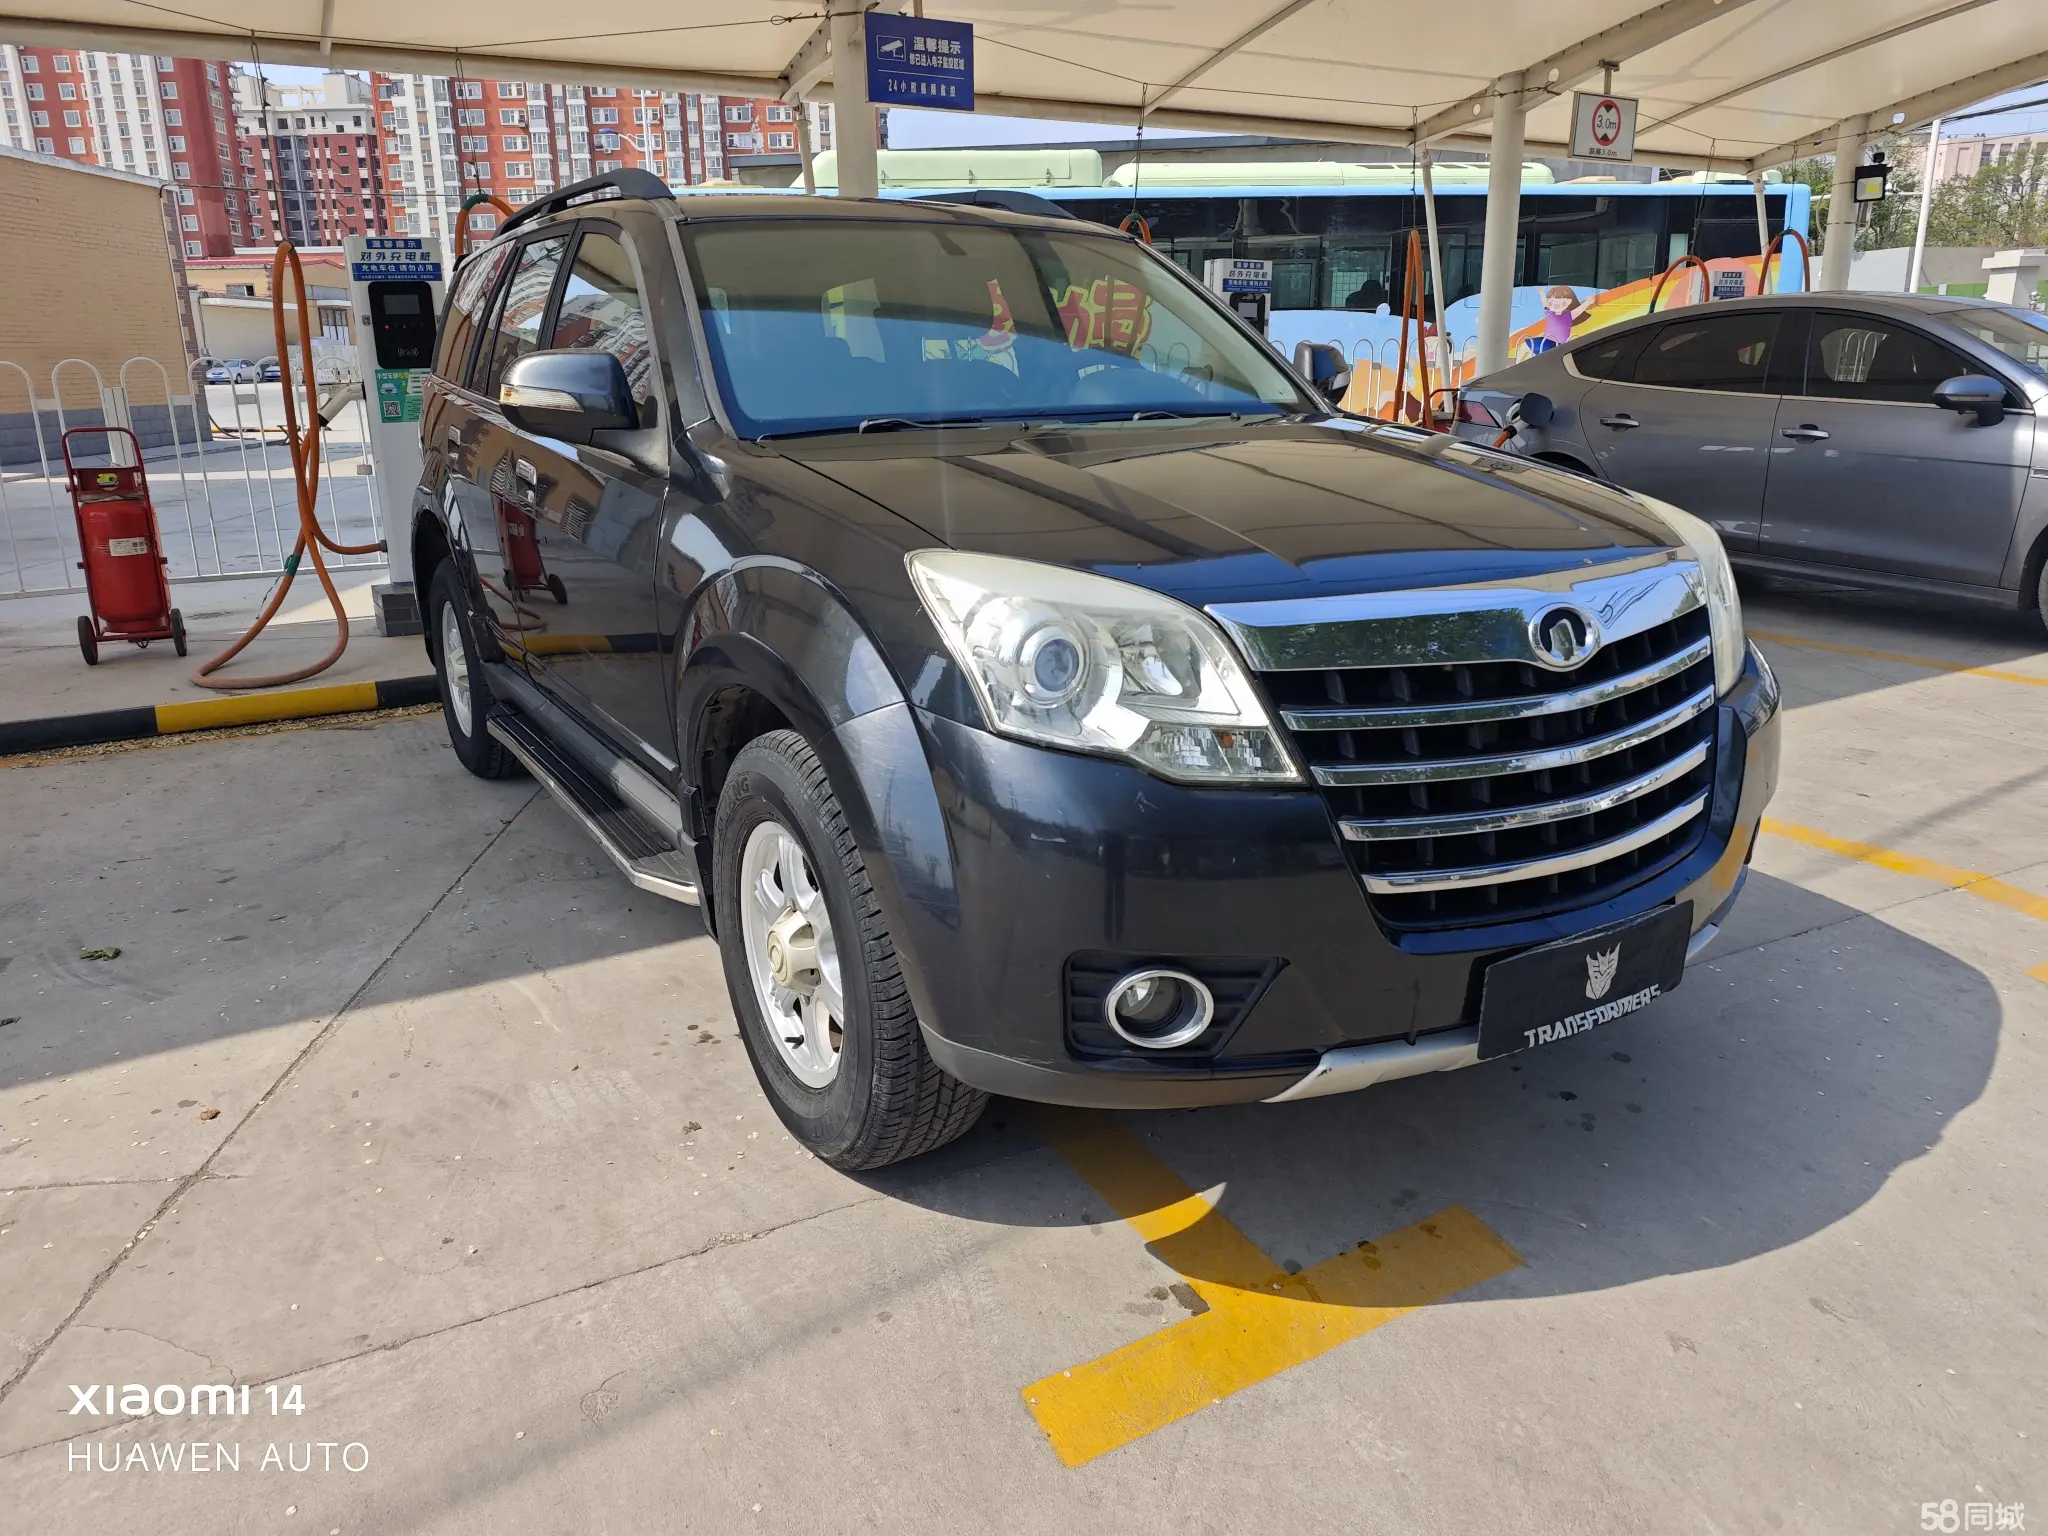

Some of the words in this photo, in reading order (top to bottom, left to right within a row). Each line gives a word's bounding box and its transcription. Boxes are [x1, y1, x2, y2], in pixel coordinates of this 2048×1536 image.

[913, 36, 961, 55] 温馨提示
[1597, 114, 1617, 130] 3.0m
[360, 251, 432, 261] 对外充电桩
[361, 264, 397, 272] 充电车位
[1524, 983, 1662, 1048] TRANSFORMERS
